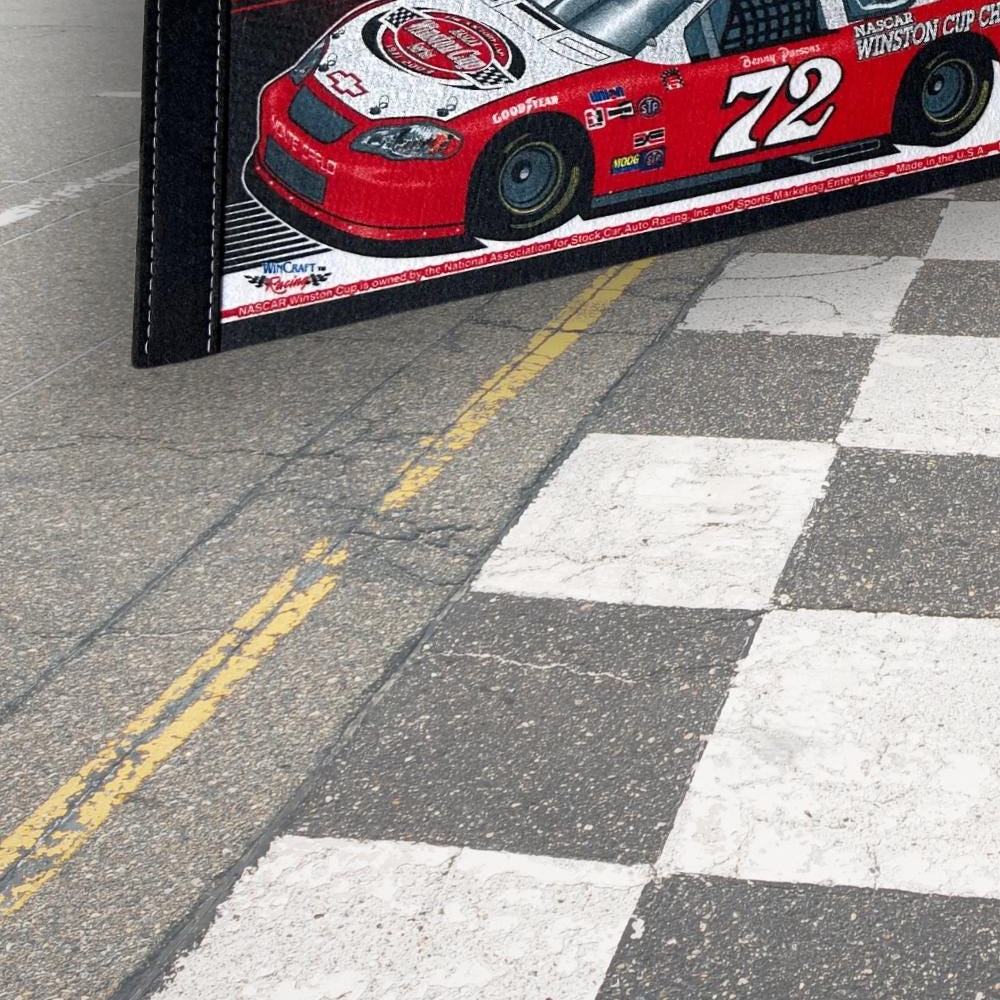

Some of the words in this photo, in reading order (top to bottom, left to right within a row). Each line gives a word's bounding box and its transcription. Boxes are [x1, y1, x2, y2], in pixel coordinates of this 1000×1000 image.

[853, 11, 915, 38] NASCAR
[856, 18, 939, 61] WINSTON
[942, 9, 976, 36] CUP
[640, 97, 660, 116] STP
[710, 56, 843, 162] 72
[613, 153, 641, 169] MOOG
[896, 160, 924, 173] Made
[926, 156, 936, 167] in
[938, 152, 954, 165] the
[238, 298, 287, 317] NASCAR
[289, 289, 334, 306] Winston
[335, 284, 358, 298] Cup
[360, 280, 369, 292] is
[372, 271, 407, 287] owned
[409, 269, 424, 284] by
[425, 264, 442, 277] the
[444, 254, 488, 272] National
[489, 242, 551, 263] Association
[553, 237, 569, 249] for
[571, 230, 601, 245] Stock
[603, 224, 622, 237] Car
[624, 219, 649, 233] Auto
[715, 200, 735, 214] and
[737, 192, 772, 211] Sports
[773, 181, 826, 201] Marketing
